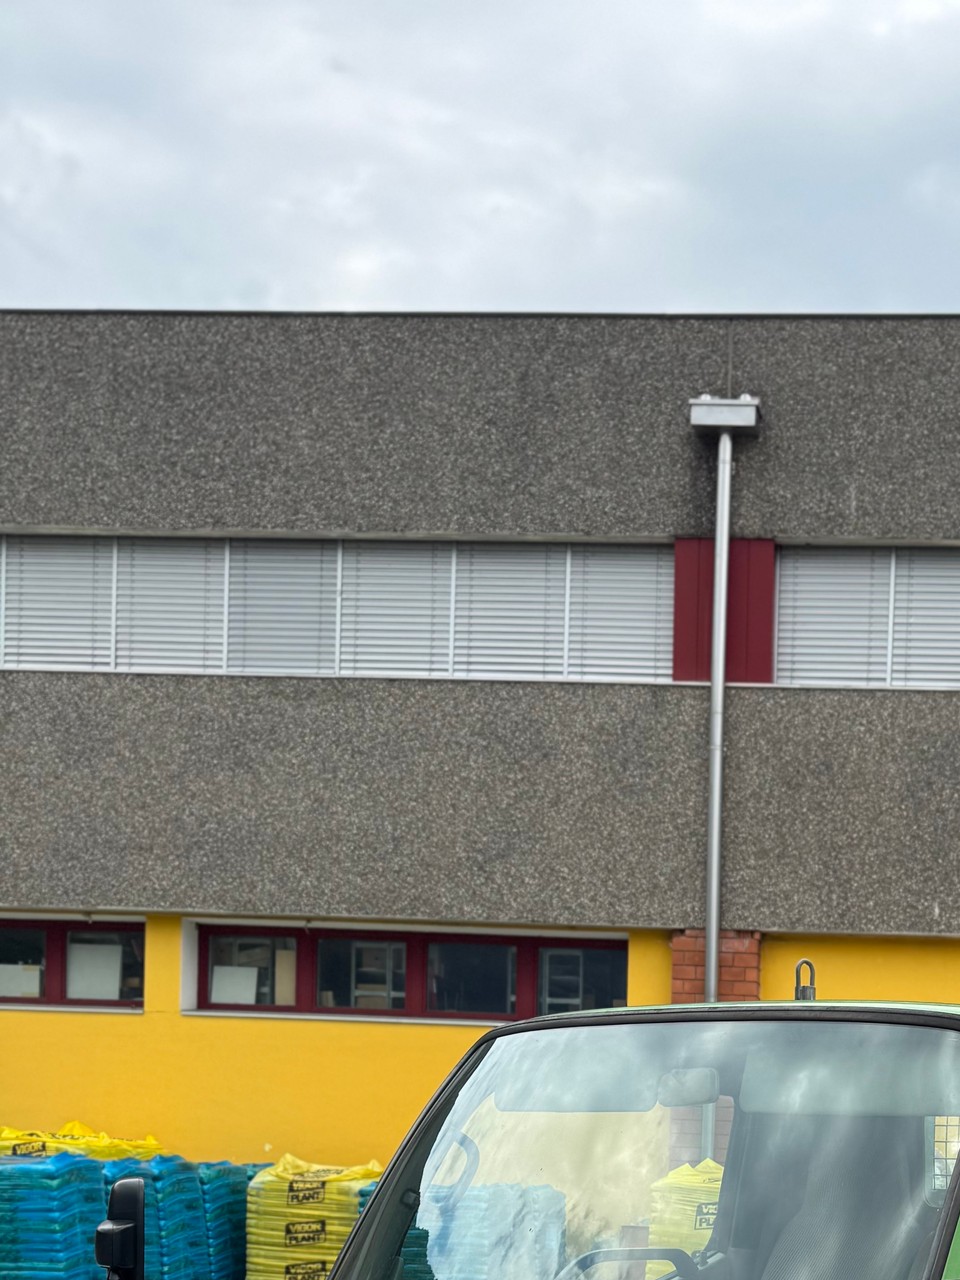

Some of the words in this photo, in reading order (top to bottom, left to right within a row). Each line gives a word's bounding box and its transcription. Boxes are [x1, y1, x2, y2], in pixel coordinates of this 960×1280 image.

[15, 1142, 45, 1153] VIGOR
[289, 1222, 321, 1233] VIGOR
[288, 1233, 321, 1245] PLANT
[289, 1262, 322, 1274] VIGOR
